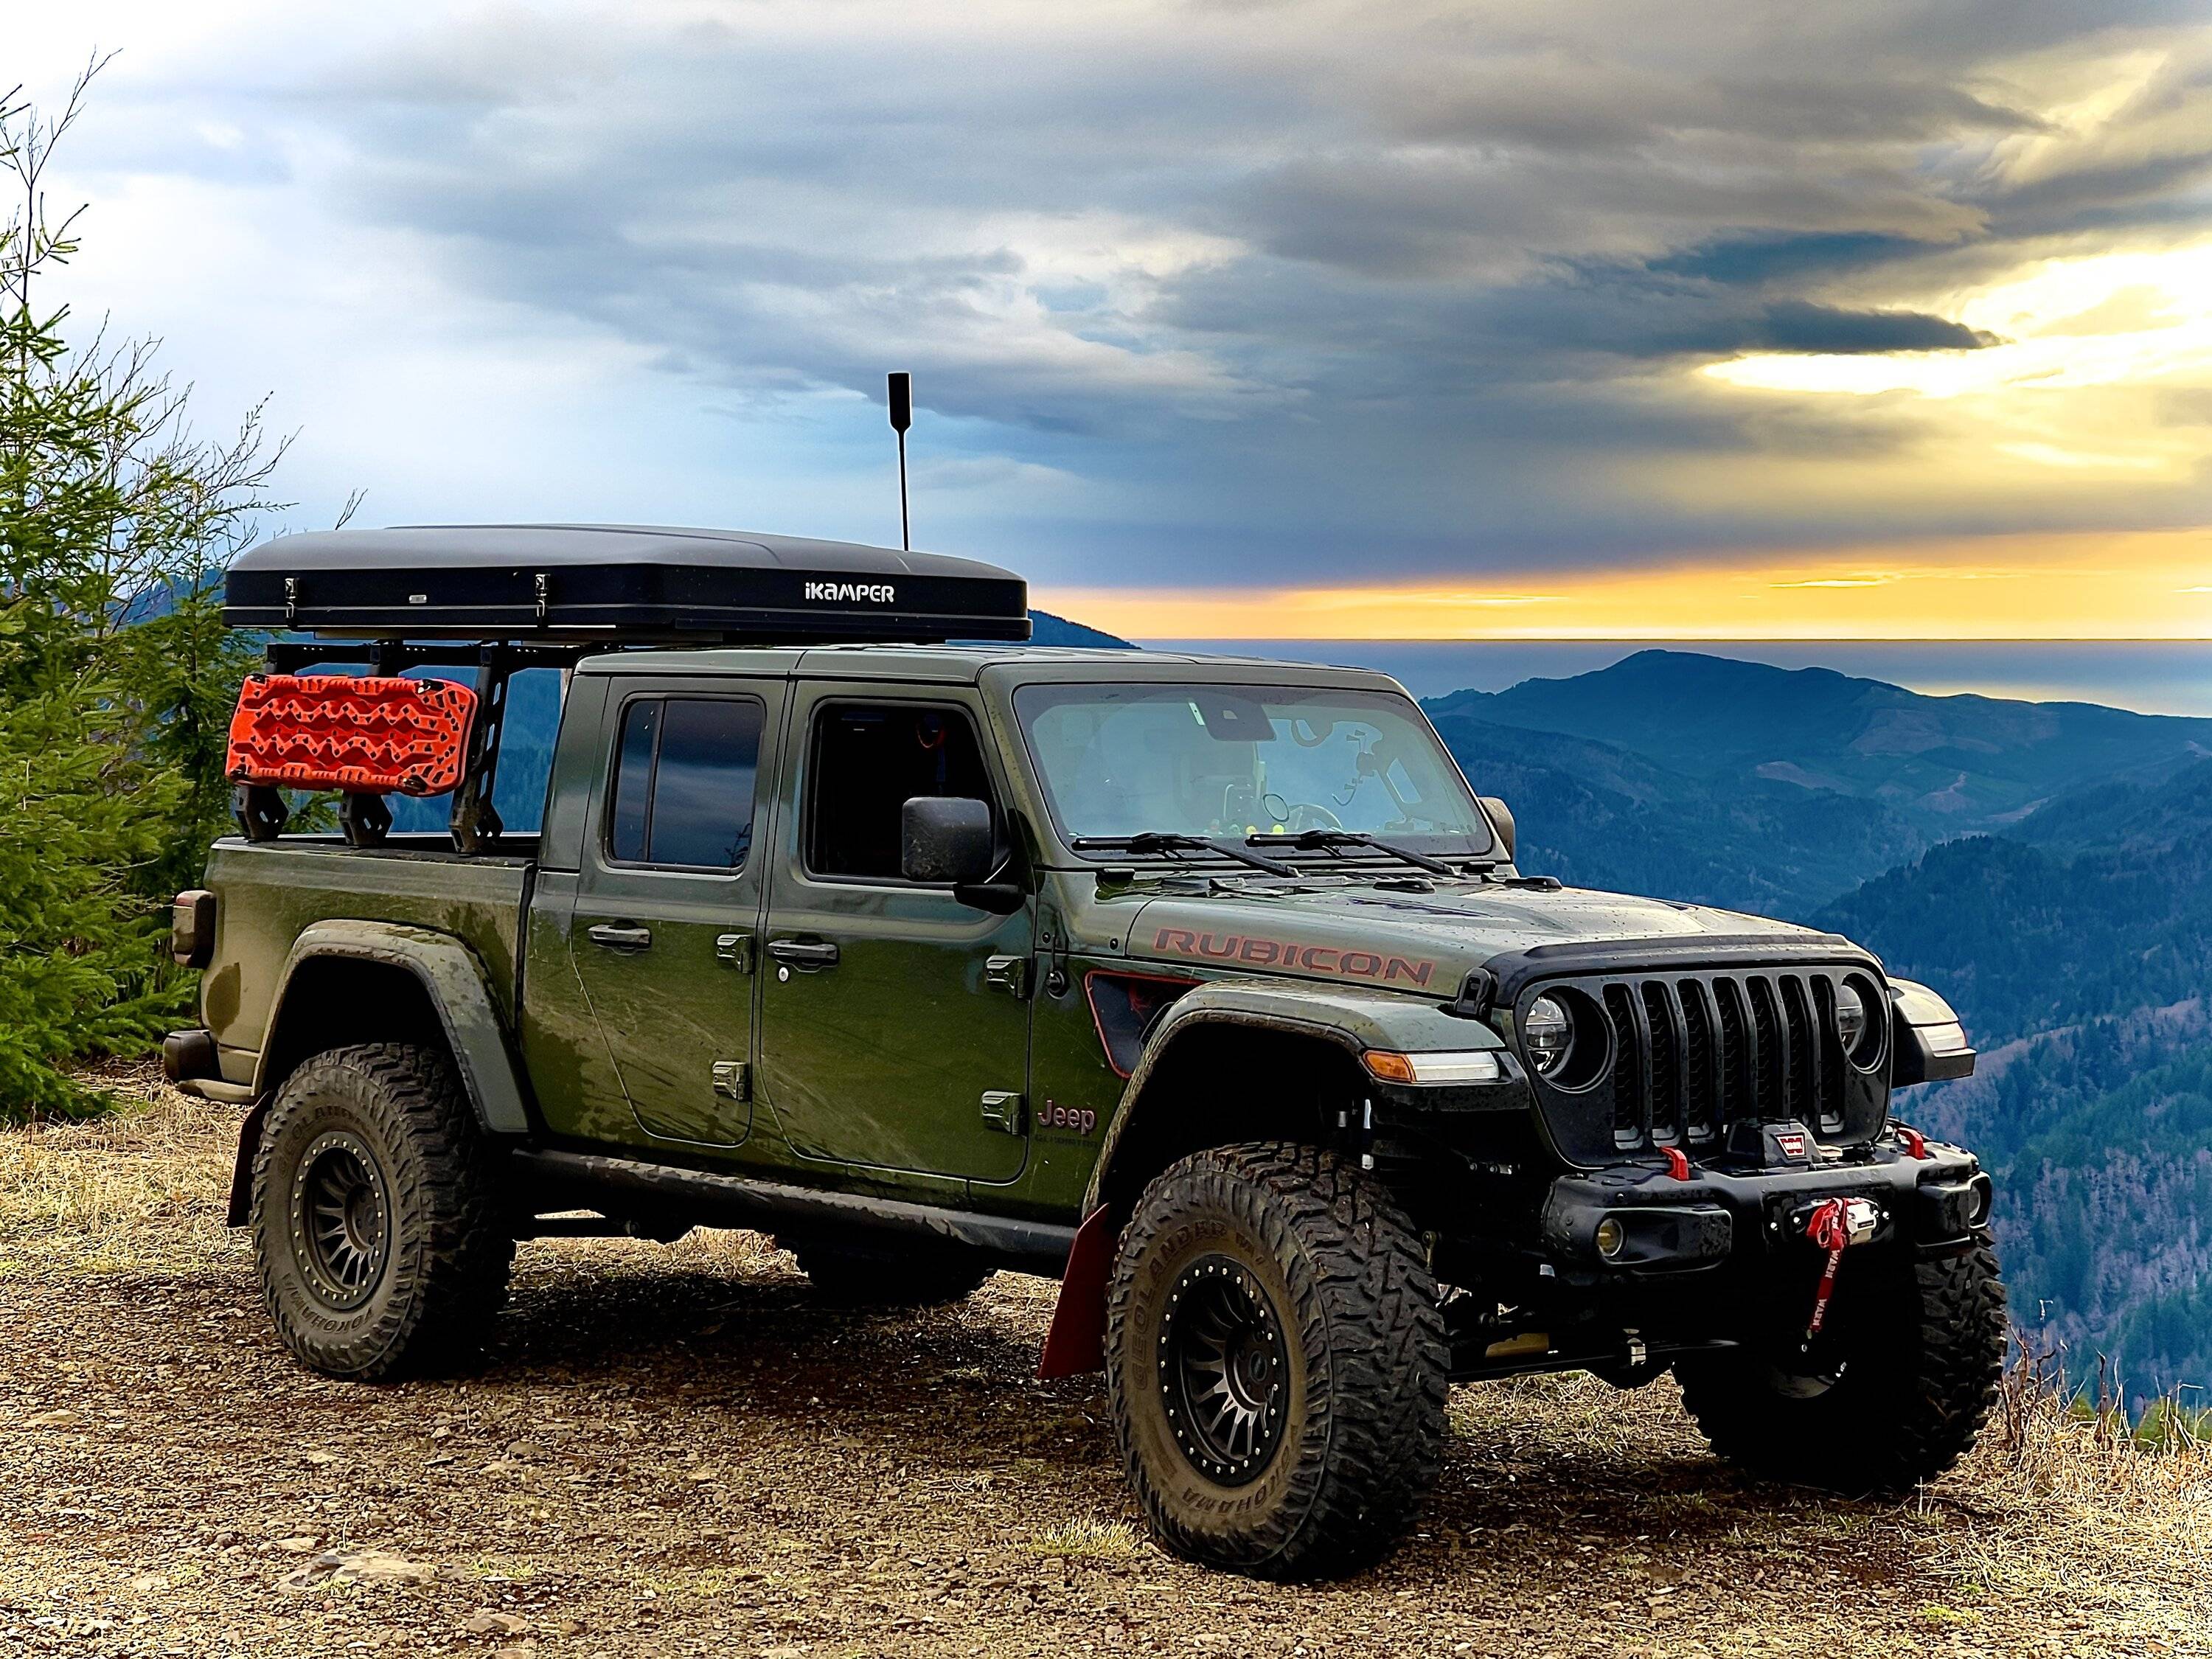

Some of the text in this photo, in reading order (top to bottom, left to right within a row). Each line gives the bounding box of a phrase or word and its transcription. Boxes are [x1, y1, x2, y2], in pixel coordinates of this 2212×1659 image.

[1154, 927, 1436, 987] RUBICON
[1037, 1099, 1095, 1135] Jeep
[1825, 1250, 1841, 1279] WARN
[1812, 1298, 1828, 1326] WARN
